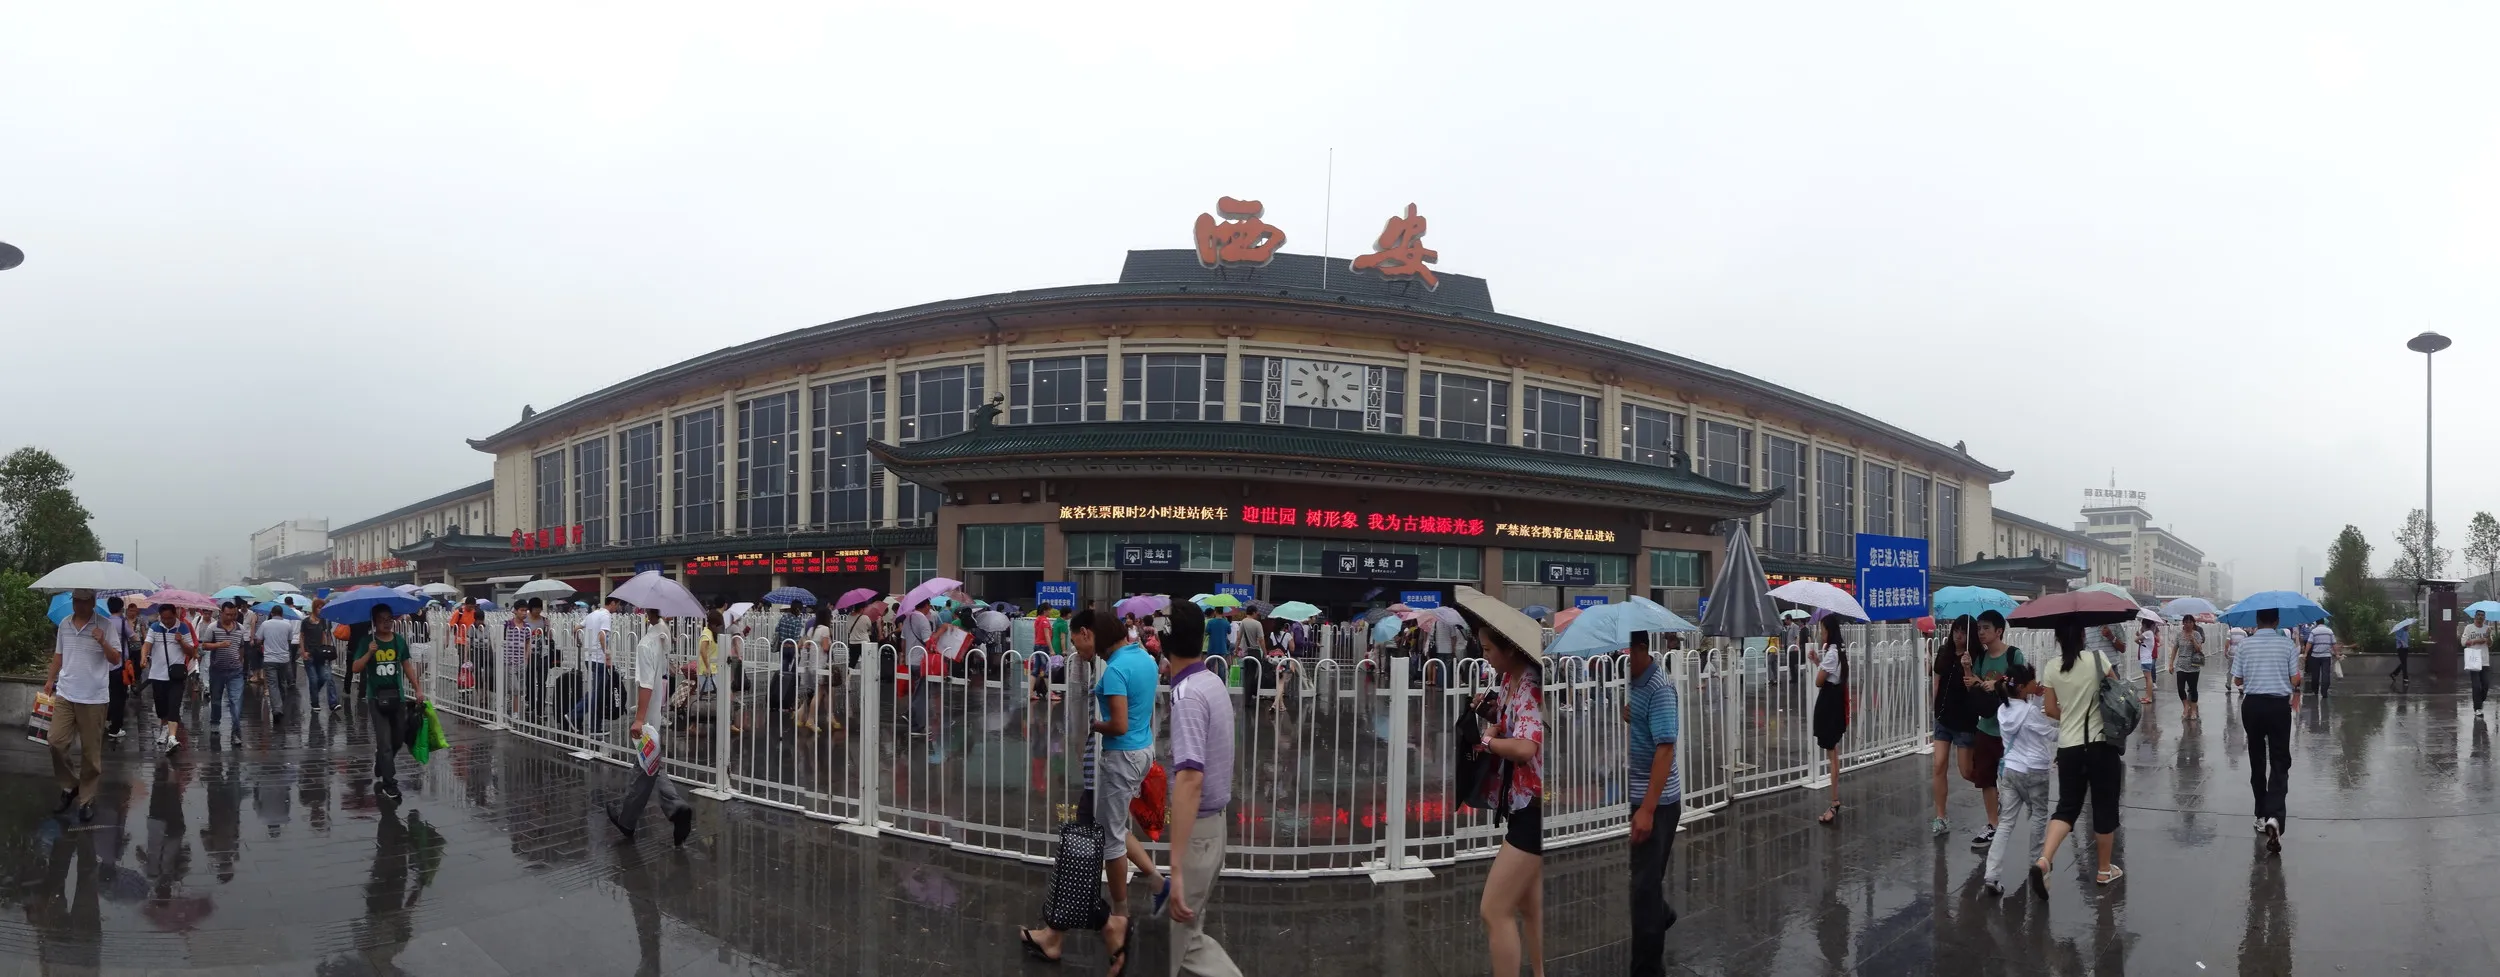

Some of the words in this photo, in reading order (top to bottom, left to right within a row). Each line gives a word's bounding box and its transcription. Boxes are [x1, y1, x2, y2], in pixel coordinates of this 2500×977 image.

[1059, 505, 1228, 521] 旅客凭票限时2小时进站候车
[1242, 505, 1297, 526] 迎世园
[1305, 508, 1359, 529] 树形象
[1367, 512, 1485, 536] 我为古城添光彩
[1495, 523, 1616, 542] 严禁旅客携带危险品进站
[1363, 557, 1404, 568] 进站口
[1869, 547, 1920, 568] 您已进入安检区
[1565, 566, 1590, 576] 进站口
[1868, 587, 1920, 608] 请自觉接受安检
[375, 648, 396, 662] no
